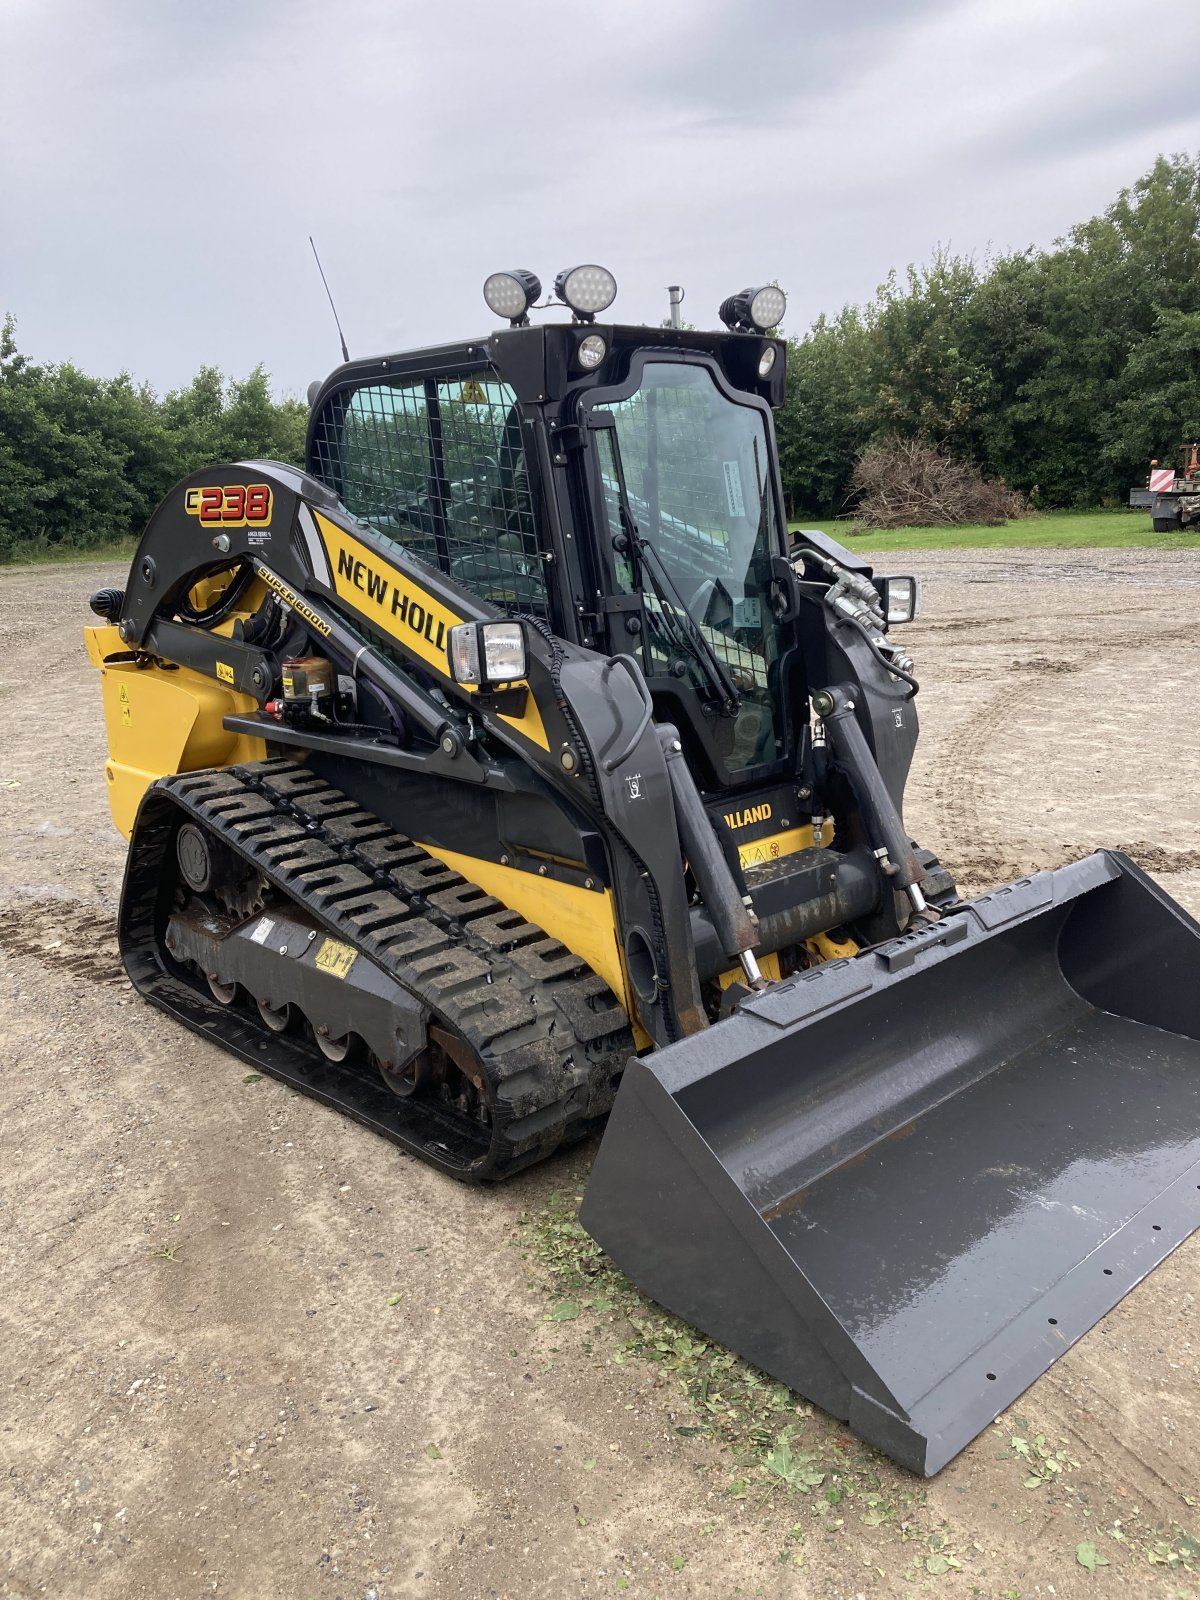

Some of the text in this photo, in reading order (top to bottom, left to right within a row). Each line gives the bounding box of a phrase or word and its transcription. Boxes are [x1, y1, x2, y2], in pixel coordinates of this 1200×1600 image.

[185, 485, 272, 526] C238
[258, 567, 332, 638] SUPER BOOM
[337, 547, 446, 654] NEW HOLL
[724, 804, 772, 829] LLAND
